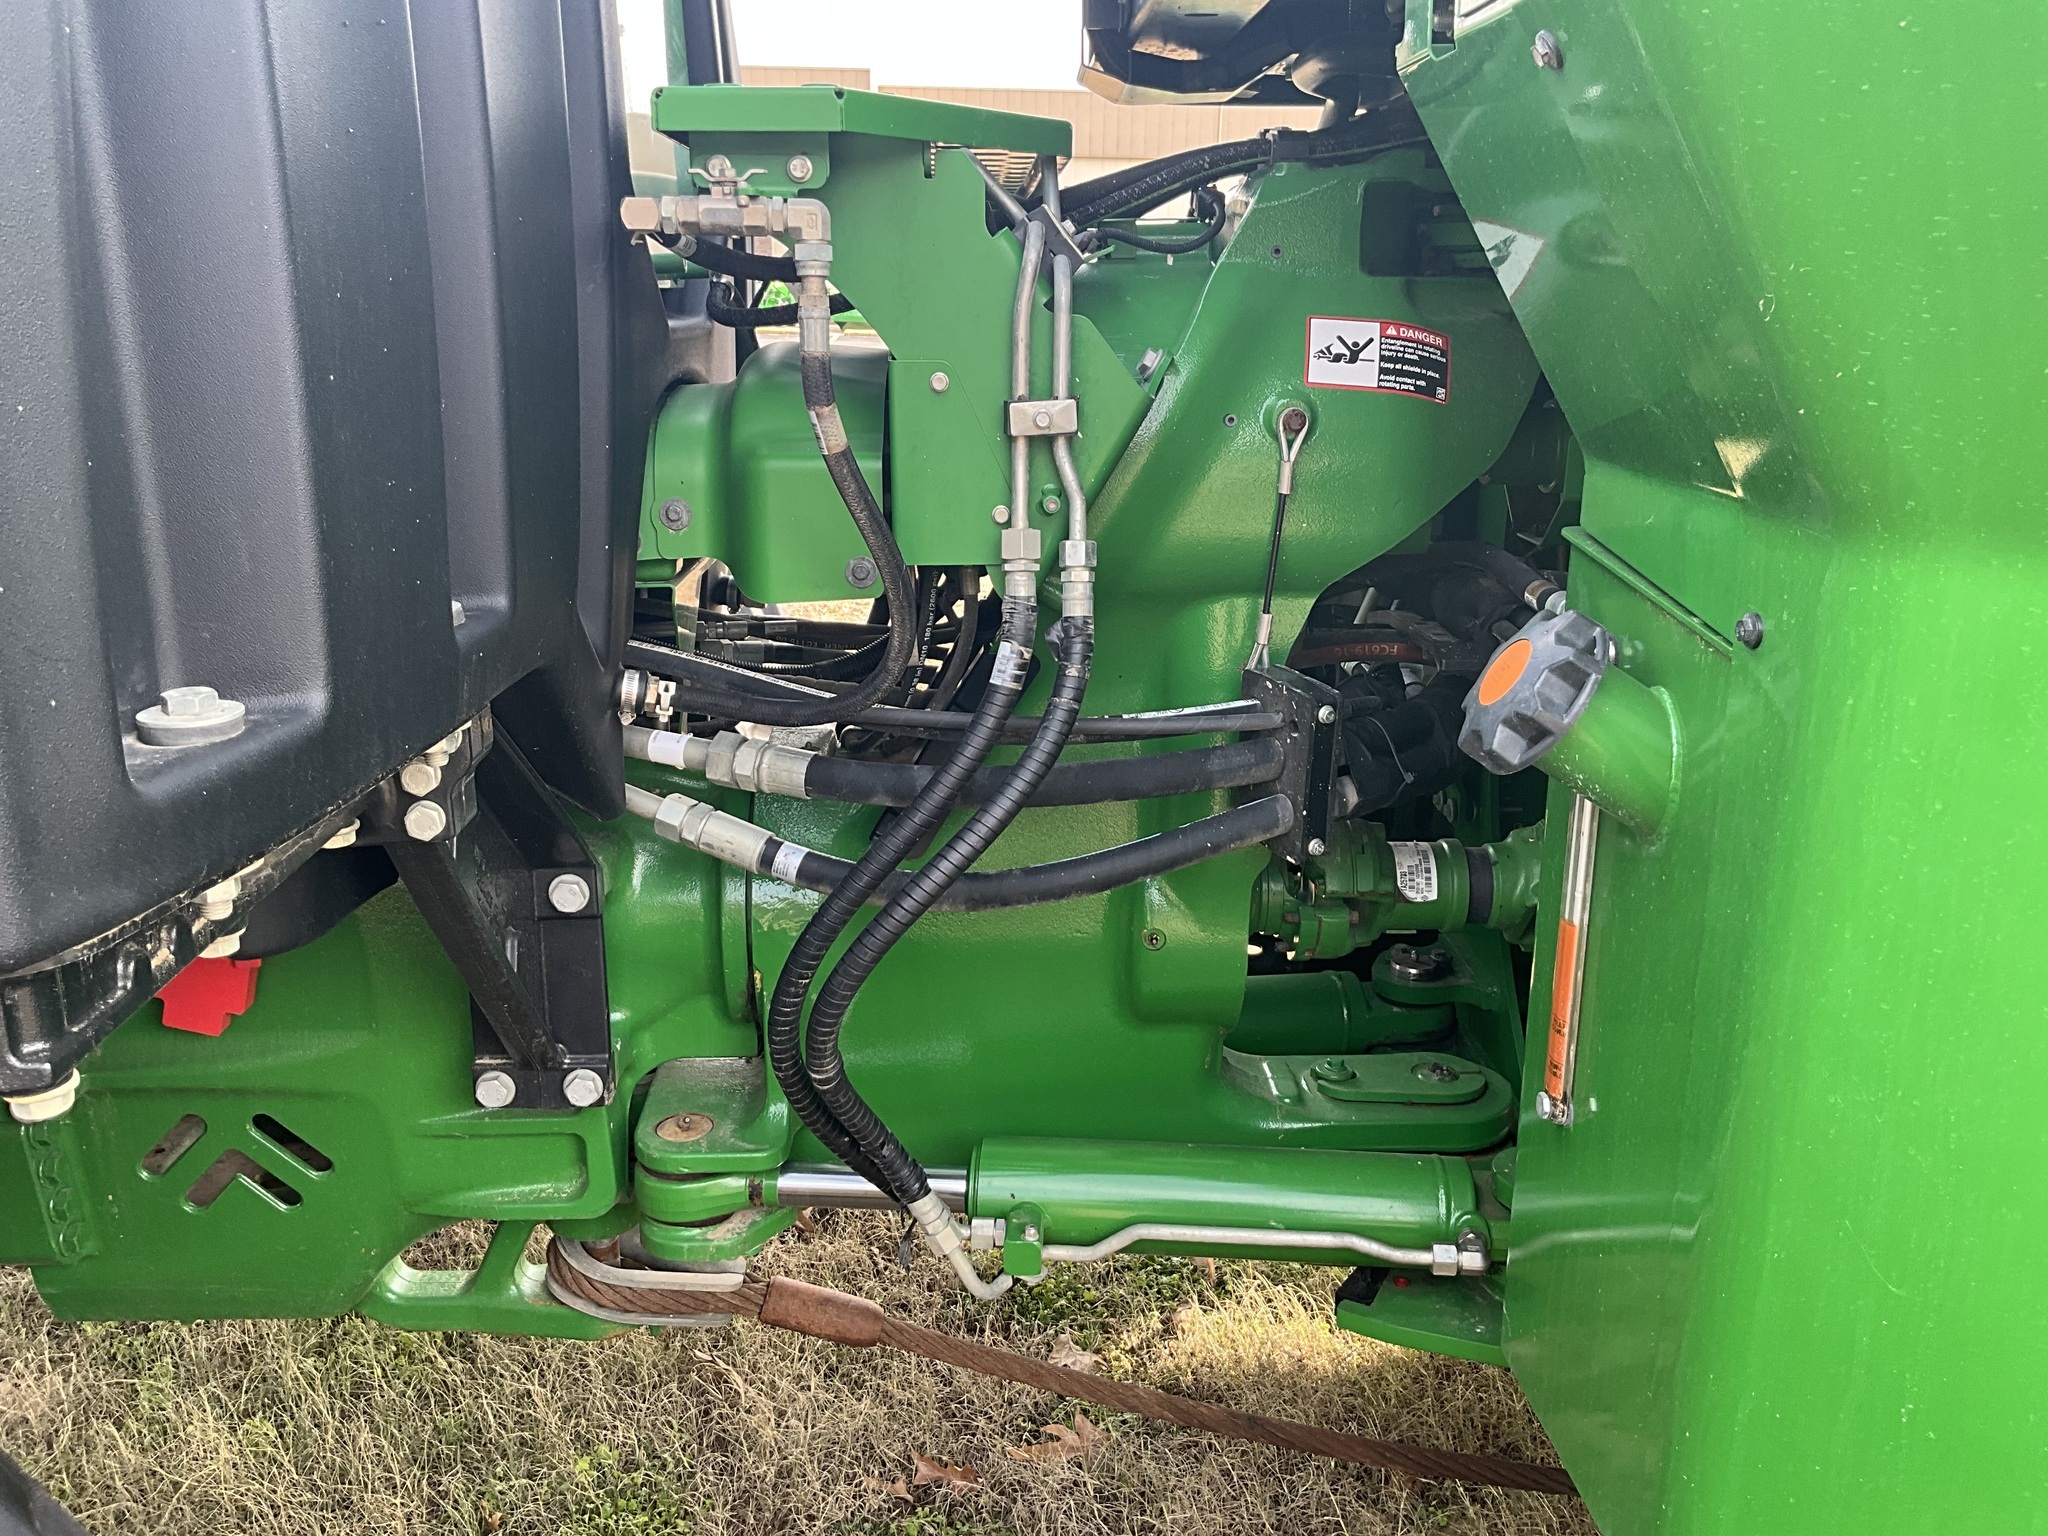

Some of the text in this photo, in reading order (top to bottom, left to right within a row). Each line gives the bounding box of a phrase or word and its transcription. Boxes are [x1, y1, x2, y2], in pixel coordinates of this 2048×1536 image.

[1400, 328, 1442, 346] DANGER
[1381, 337, 1417, 348] Entanglement
[1423, 345, 1441, 356] rotating
[1381, 343, 1404, 351] driveline
[1415, 349, 1430, 357] cause
[1430, 353, 1446, 363] serious
[1404, 353, 1420, 361] death.
[1380, 361, 1394, 369] Keep
[1402, 364, 1420, 373] shields
[1426, 370, 1440, 379] place.
[1379, 381, 1416, 391] rotating parts.
[1396, 376, 1415, 385] contact
[1416, 379, 1427, 387] with
[928, 588, 937, 611] (2600
[926, 611, 934, 626] bar
[924, 627, 932, 641] 180
[919, 645, 929, 666] DN10
[1334, 644, 1398, 656] FC619-16
